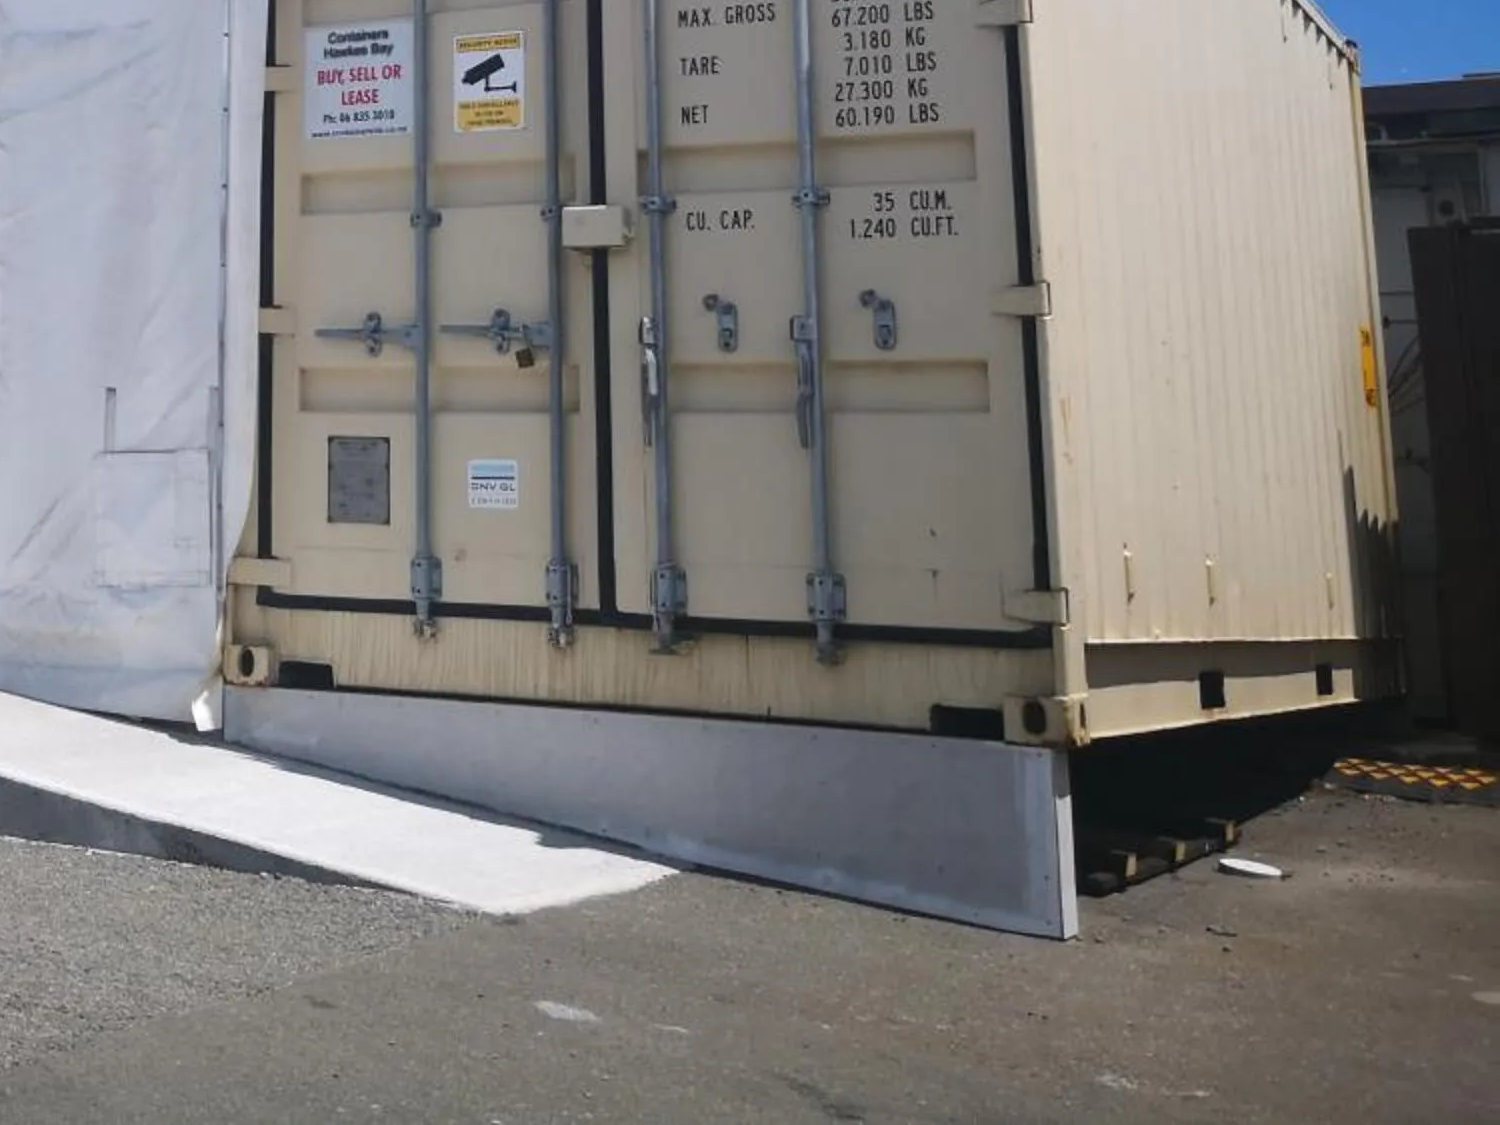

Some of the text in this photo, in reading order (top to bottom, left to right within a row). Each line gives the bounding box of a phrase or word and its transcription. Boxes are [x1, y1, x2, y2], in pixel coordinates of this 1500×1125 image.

[725, 2, 777, 25] GROSS
[831, 0, 934, 27] 67.200 LBS
[370, 42, 394, 57] Bay
[843, 26, 926, 52] 3.180 KG
[348, 66, 379, 83] SELL
[381, 64, 402, 81] OR
[680, 55, 721, 76] TARE
[844, 51, 937, 76] 7.010 LBS
[341, 88, 380, 106] LEASE
[835, 77, 929, 103] 27.300 KG
[681, 104, 709, 124] NET
[835, 102, 940, 128] 60.190 LBS
[873, 192, 896, 212] 35
[686, 211, 711, 231] CU.
[850, 217, 897, 239] 1.240
